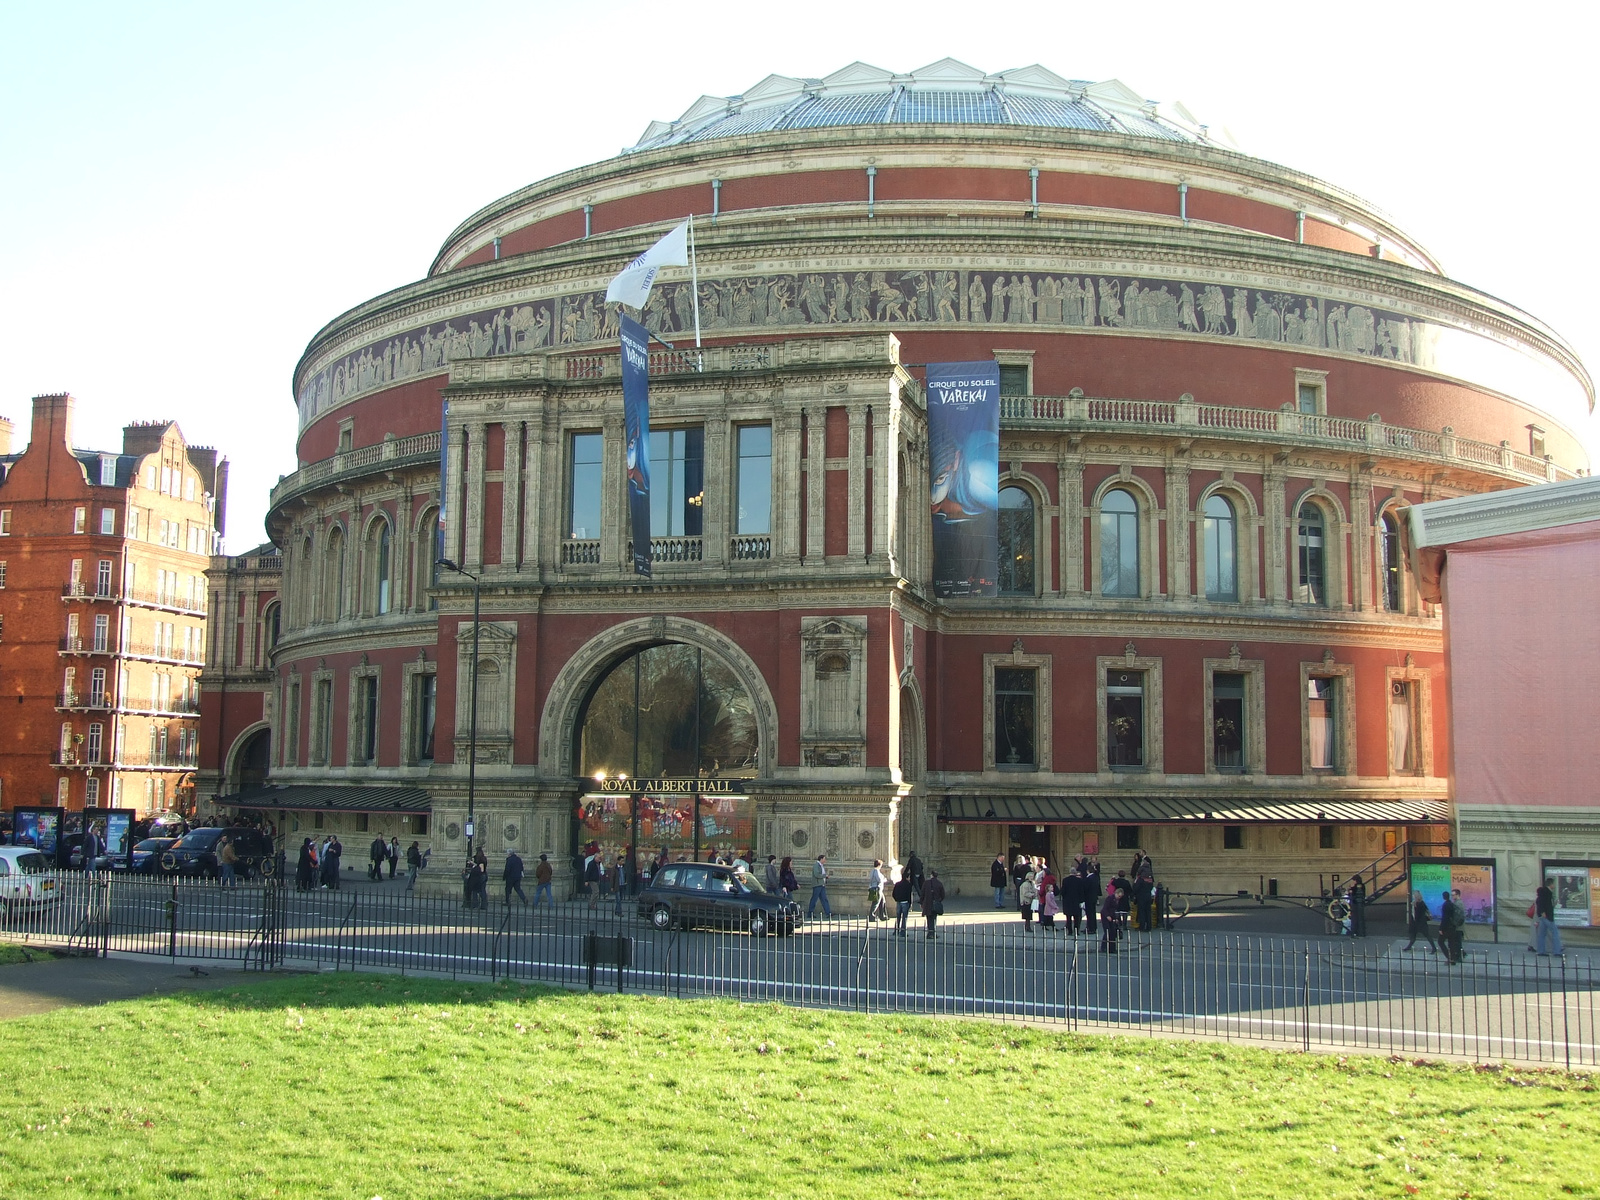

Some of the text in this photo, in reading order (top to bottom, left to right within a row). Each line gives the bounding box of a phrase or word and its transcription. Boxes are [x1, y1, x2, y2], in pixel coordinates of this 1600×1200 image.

[640, 268, 655, 290] SOLEIL
[788, 260, 810, 268] THIS
[826, 259, 852, 267] HALL
[869, 257, 891, 265] WAS
[908, 256, 953, 265] ERECTED
[969, 256, 989, 265] FOR
[1006, 257, 1026, 266] THE
[1042, 259, 1117, 270] ADVANCEMENT
[1132, 263, 1144, 272] OF
[1160, 265, 1178, 275] THE
[1192, 268, 1216, 277] ARTS
[1230, 272, 1249, 282] AND
[1262, 276, 1301, 290] SCIENCES
[1315, 284, 1333, 294] AND
[1347, 291, 1373, 302] WORKS
[426, 309, 446, 320] GLORY
[472, 300, 482, 308] TO
[492, 295, 507, 303] GOD
[518, 290, 529, 298] ON
[540, 285, 559, 295] HIGH
[572, 280, 590, 289] AND
[929, 381, 957, 389] CIRQUE
[939, 389, 987, 404] VAREKAI
[600, 780, 733, 792] ROYAL ALBERT HALL
[1453, 876, 1482, 884] MARCH
